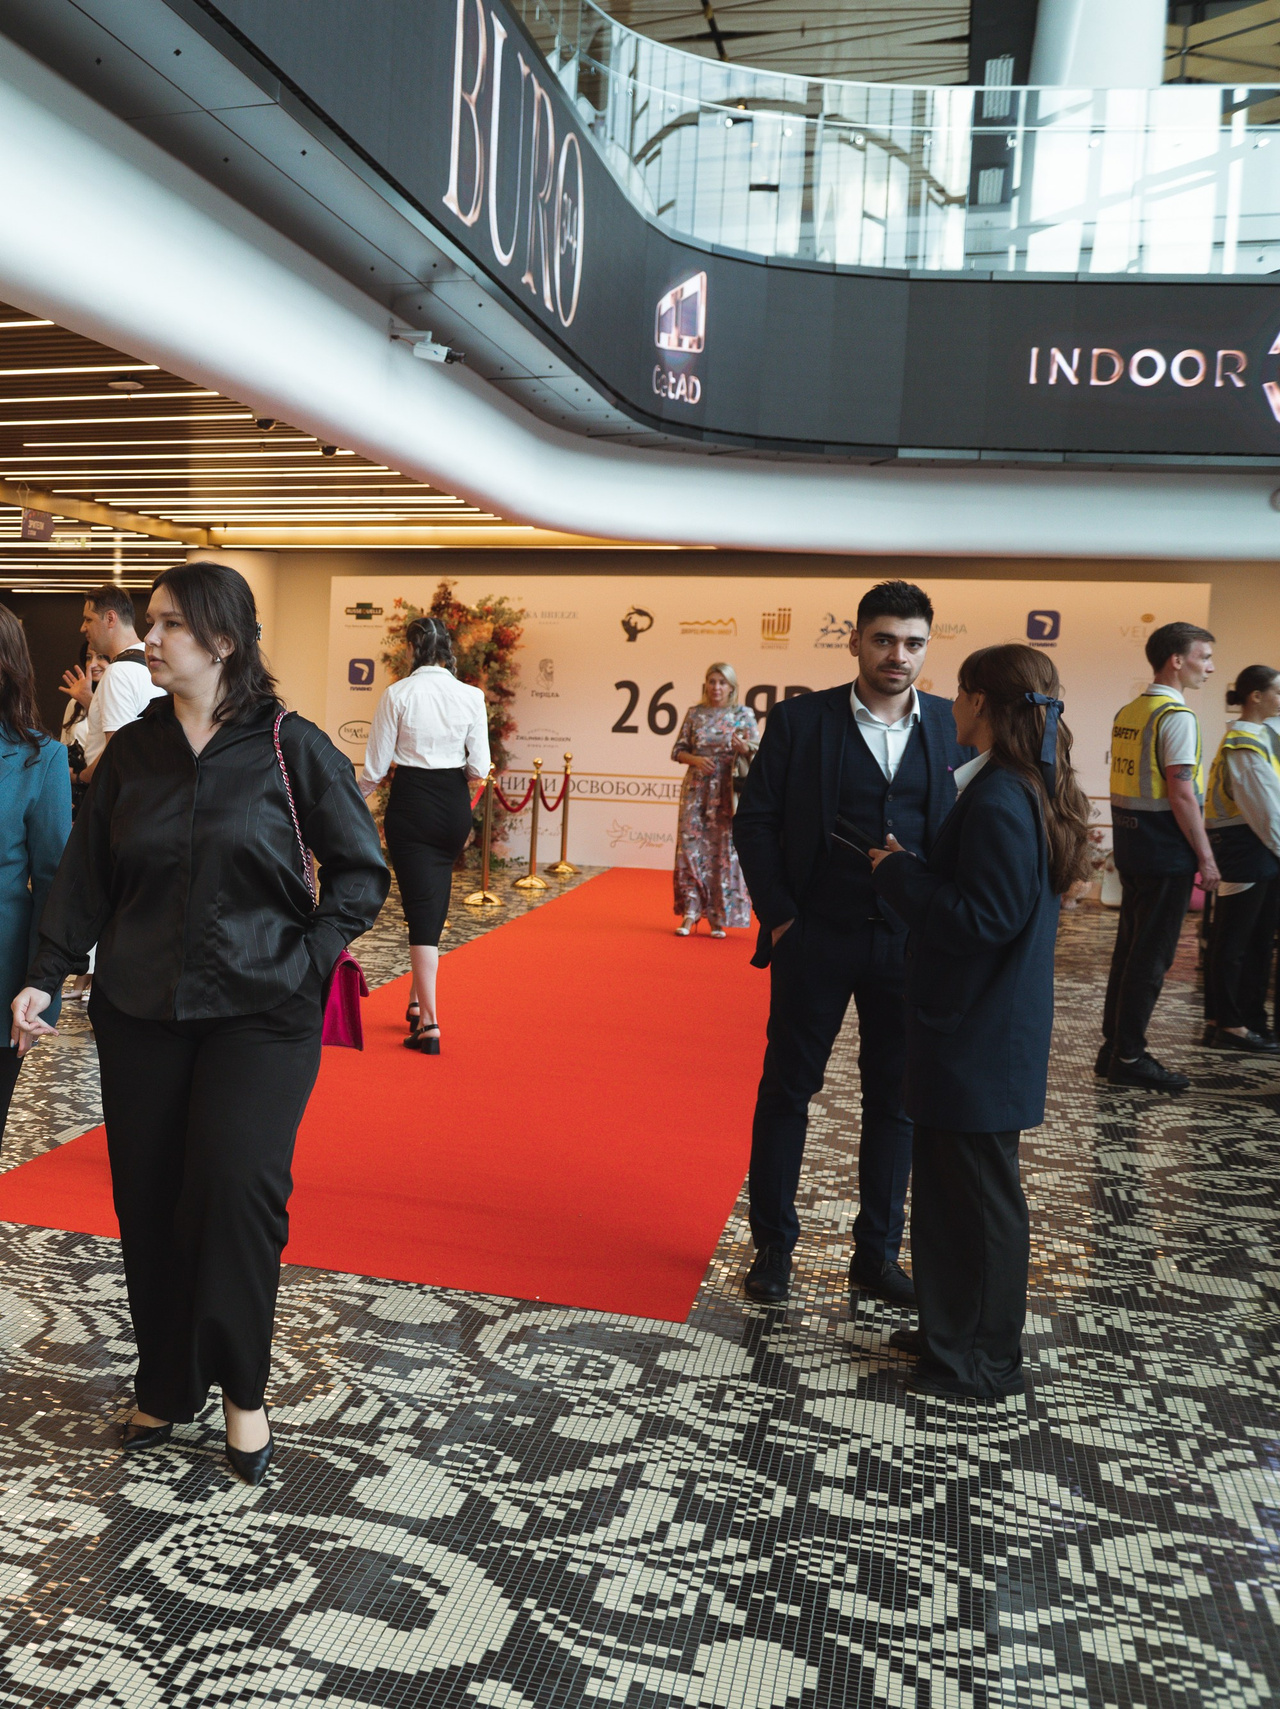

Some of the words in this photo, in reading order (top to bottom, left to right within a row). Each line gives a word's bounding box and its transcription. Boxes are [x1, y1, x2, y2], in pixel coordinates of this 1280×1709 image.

[442, 0, 584, 328] BURO
[652, 364, 702, 405] GetAD
[1028, 346, 1248, 388] INDOOR
[611, 680, 678, 736] 26
[1113, 726, 1140, 740] SAFETY
[568, 779, 681, 800] СВОБОЖДЕ
